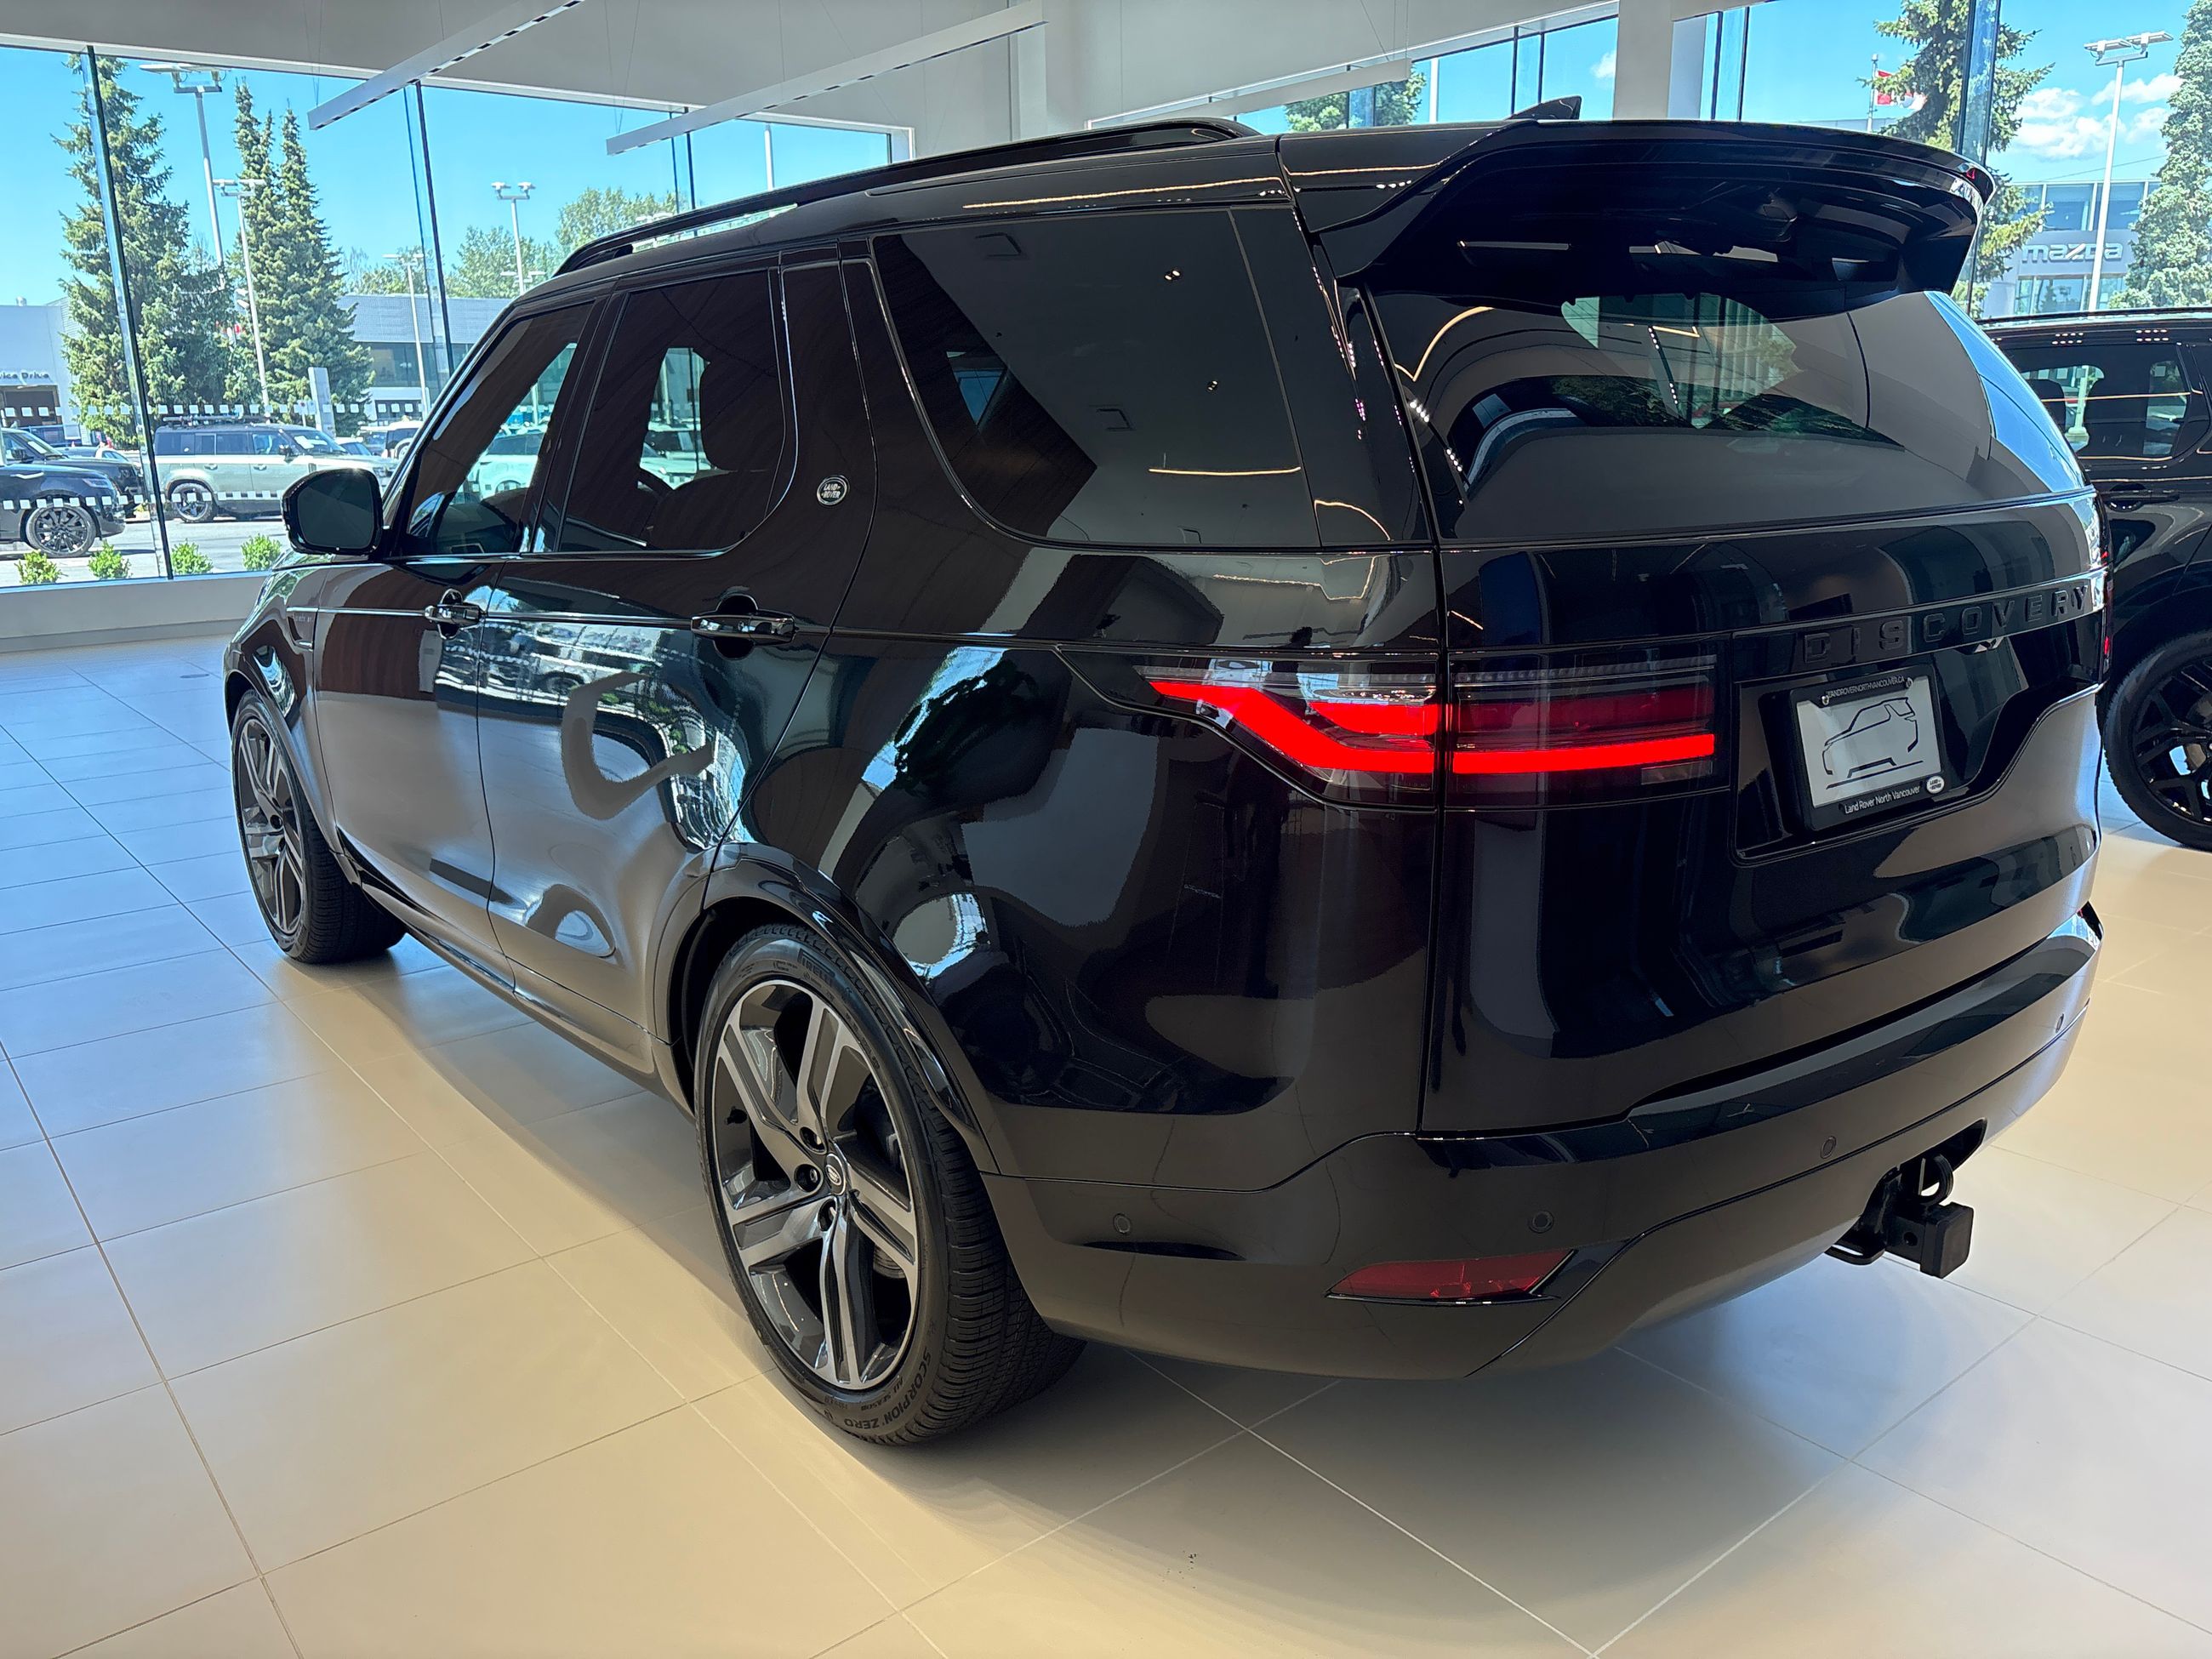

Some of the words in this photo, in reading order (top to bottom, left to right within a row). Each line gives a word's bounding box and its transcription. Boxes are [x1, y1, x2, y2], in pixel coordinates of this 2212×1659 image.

[1804, 584, 2089, 664] DISCOVERY
[1844, 802, 1859, 814] Land
[1859, 798, 1875, 811] Rover
[1875, 793, 1892, 805] North
[1892, 785, 1921, 801] Vancouver
[884, 1345, 932, 1425] SCORPION
[844, 1417, 880, 1430] ZERO
